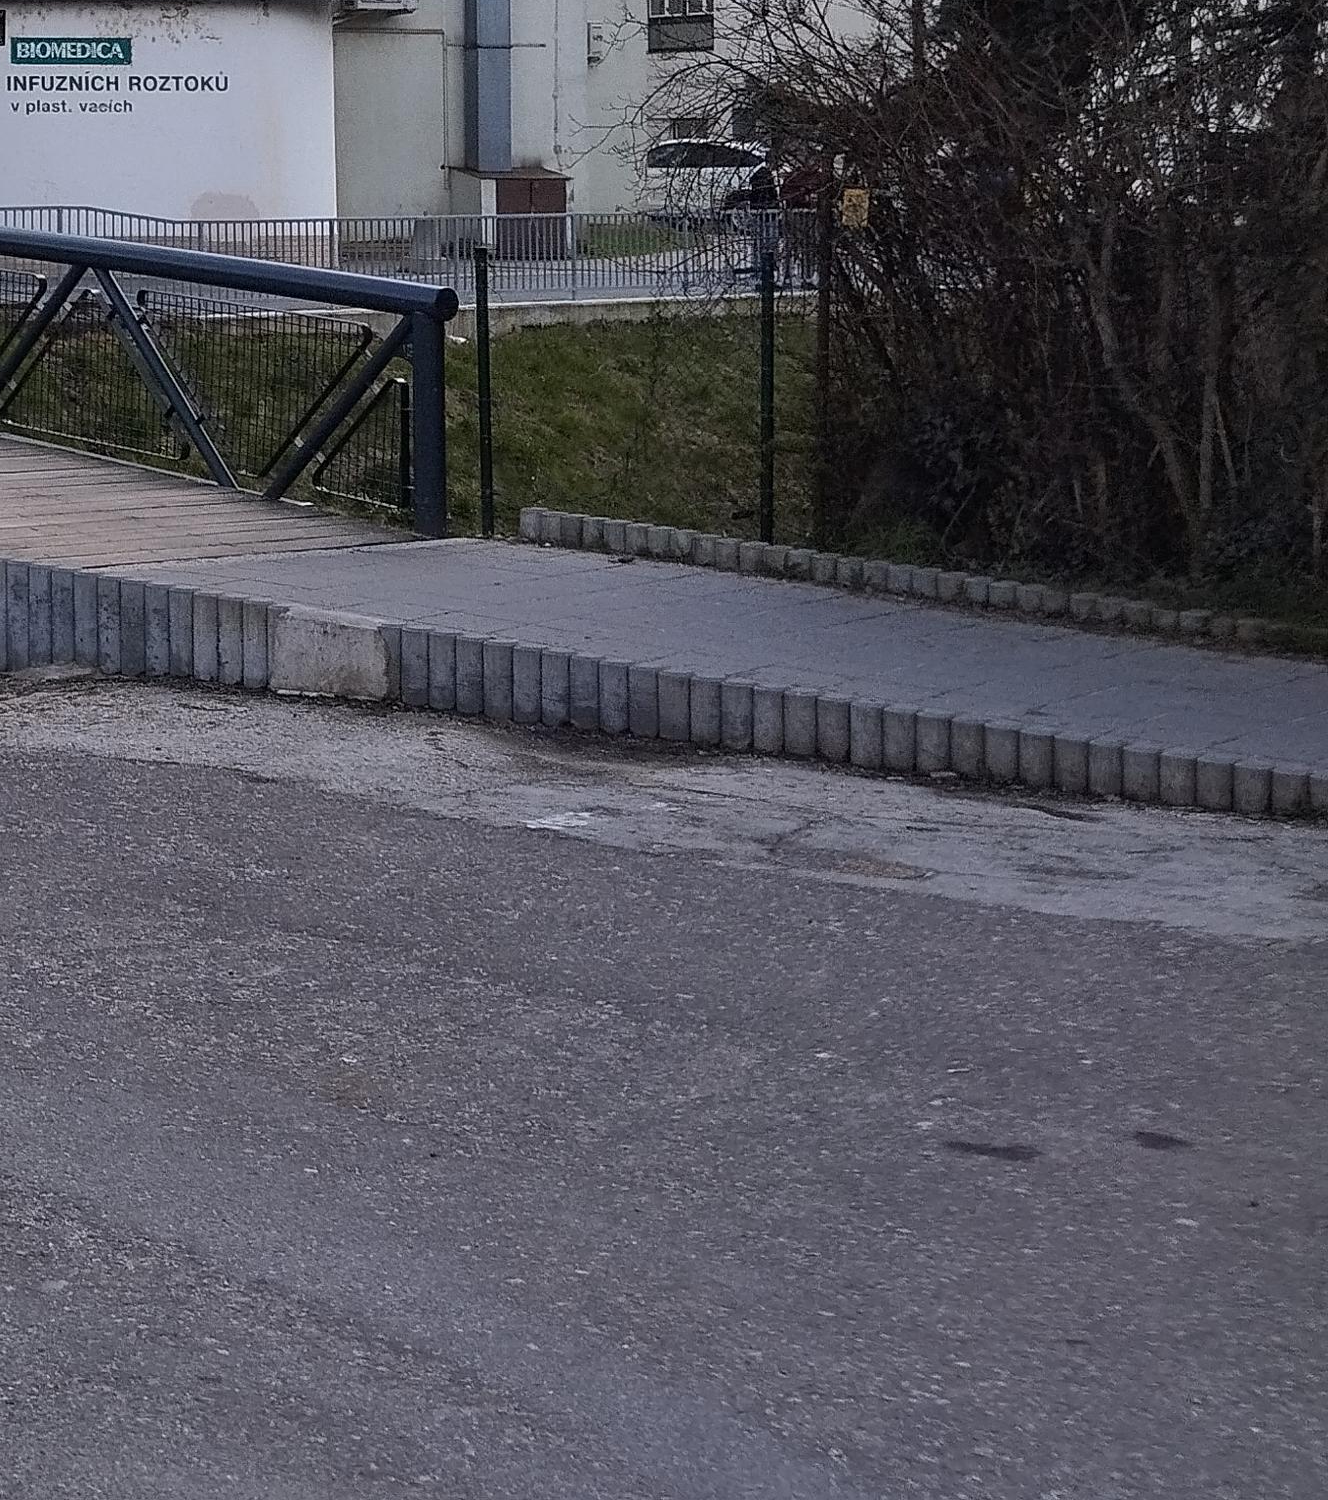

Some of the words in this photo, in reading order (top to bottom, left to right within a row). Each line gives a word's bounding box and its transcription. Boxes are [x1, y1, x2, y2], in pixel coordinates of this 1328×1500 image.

[16, 41, 124, 59] BIOMEDICA
[7, 71, 119, 92] INFUZNÍCH
[128, 70, 229, 92] ROZTOKŮ
[11, 102, 20, 112] v
[25, 100, 73, 115] plast.
